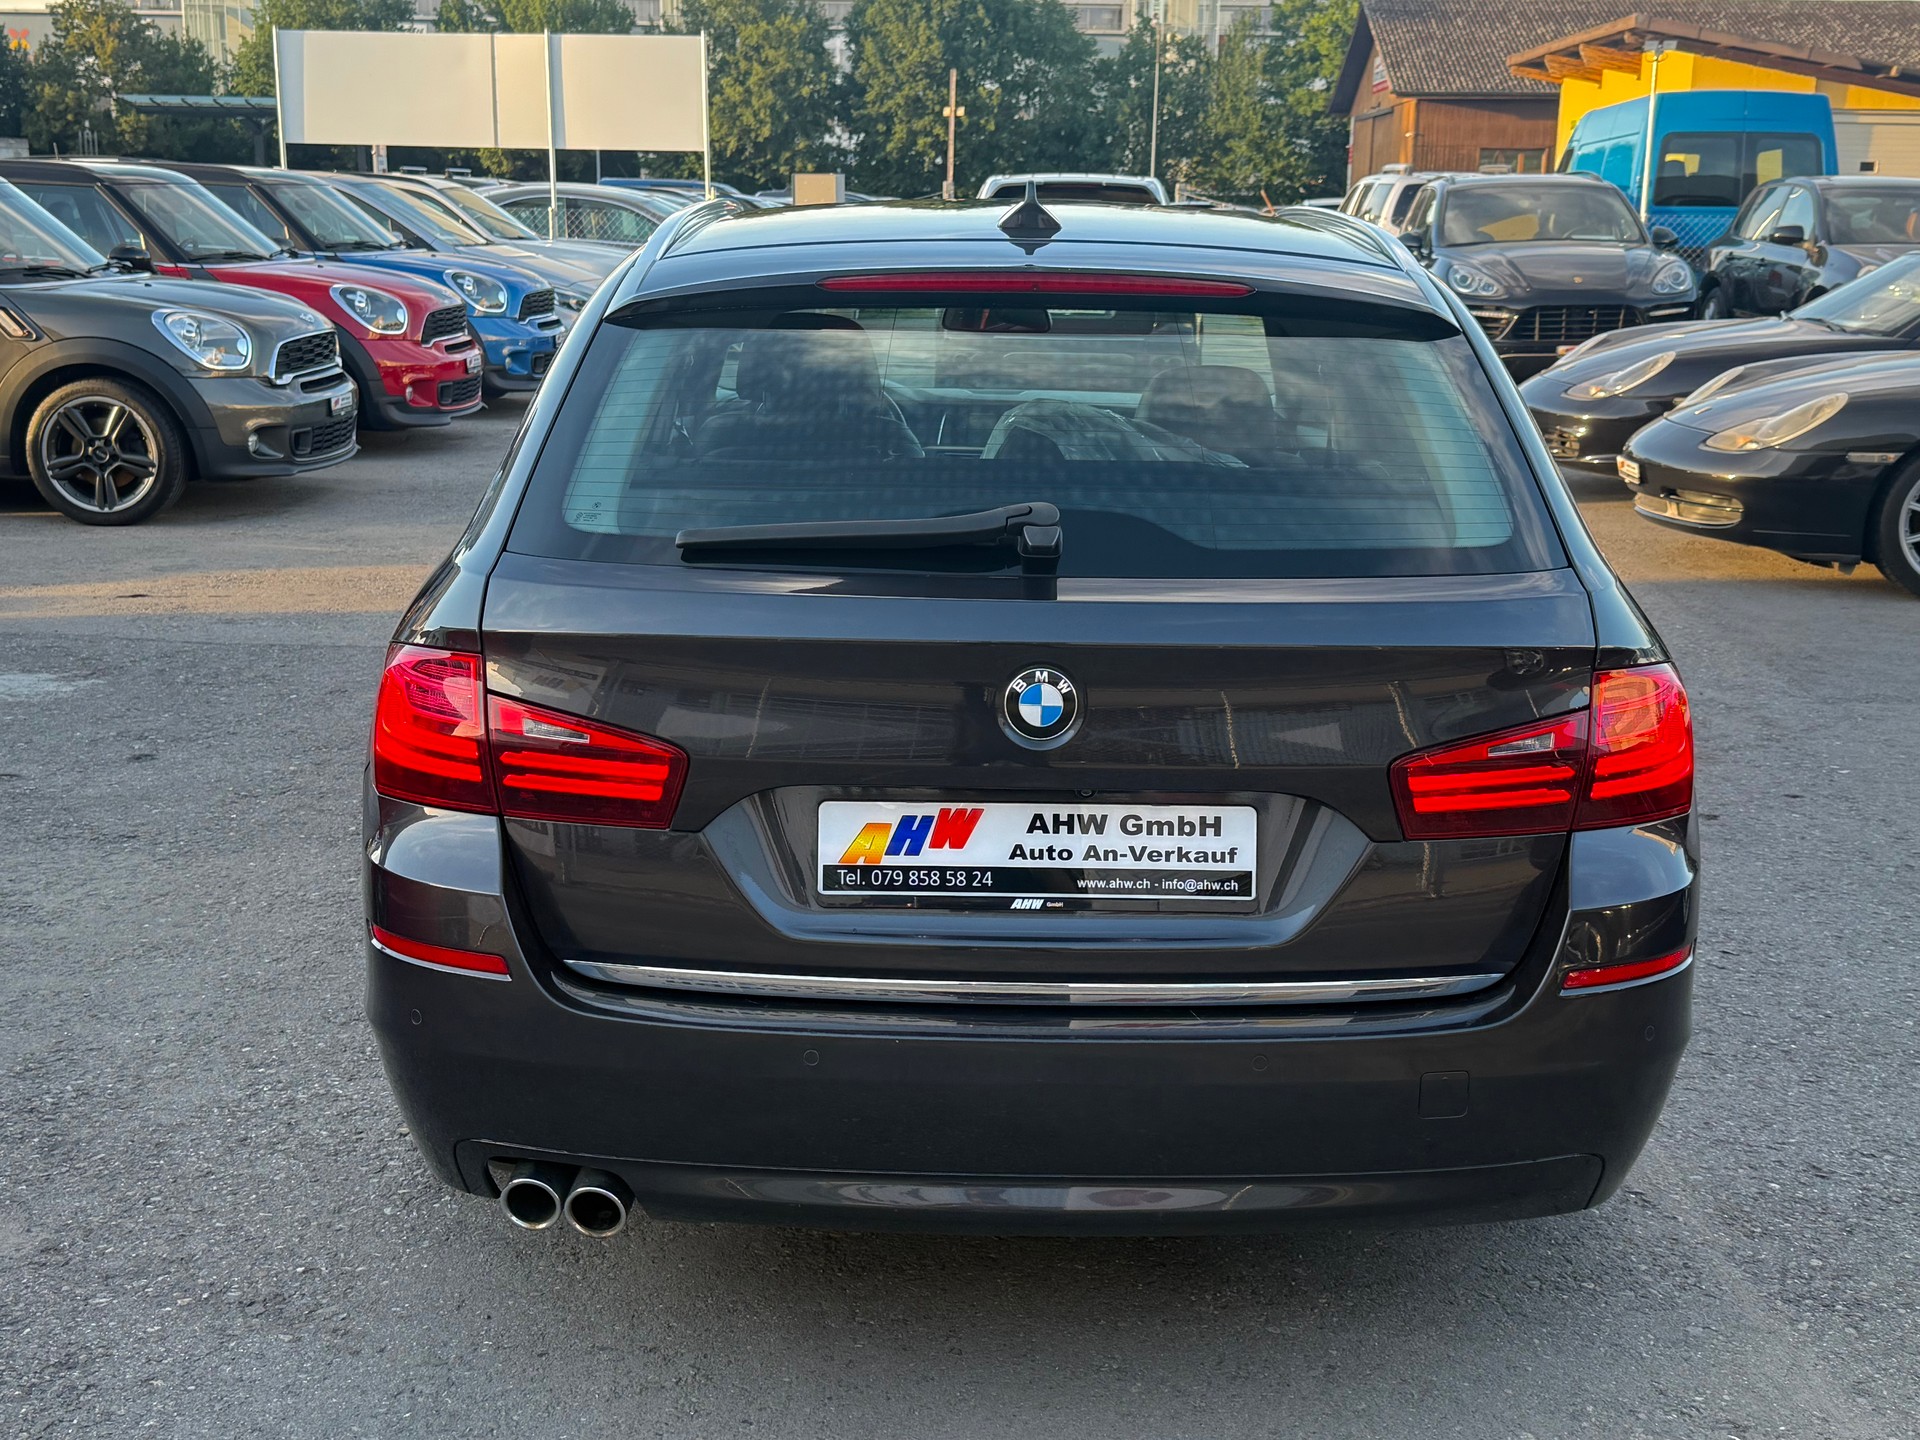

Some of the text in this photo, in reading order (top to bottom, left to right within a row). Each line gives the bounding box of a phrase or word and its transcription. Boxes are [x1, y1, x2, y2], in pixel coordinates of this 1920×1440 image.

[1012, 671, 1072, 694] BMW
[1026, 813, 1222, 837] AHW GmbH
[838, 808, 984, 864] AHW
[1008, 843, 1239, 864] Auto An-Verkauf
[837, 869, 993, 887] Tel. 079 858 58 24
[1077, 877, 1151, 890] www.ahw.ch
[1161, 878, 1239, 893] info@ahw.ch
[1010, 898, 1045, 910] AHW
